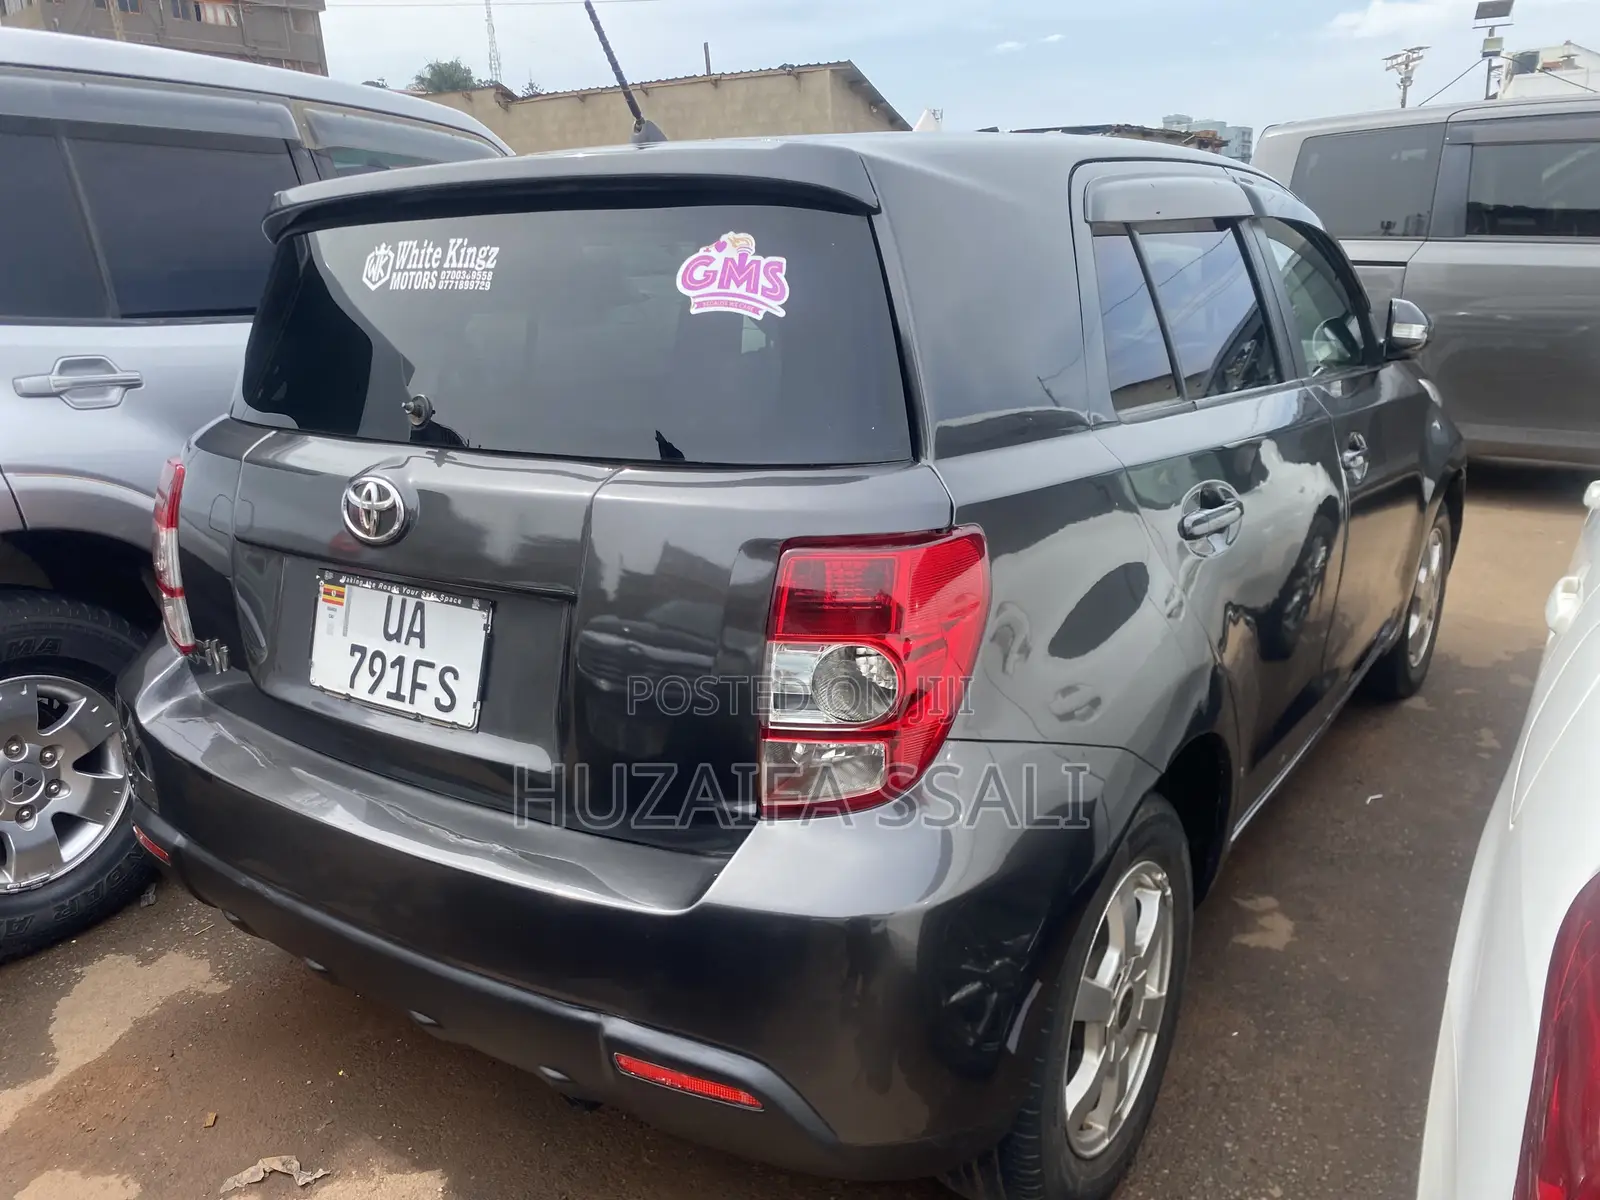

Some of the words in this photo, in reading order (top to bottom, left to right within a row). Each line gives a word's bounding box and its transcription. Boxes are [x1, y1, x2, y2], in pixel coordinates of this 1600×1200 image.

[395, 239, 442, 269] White
[443, 237, 500, 270] Kingz
[389, 270, 438, 290] MOTORS
[438, 280, 491, 291] 0771899729
[681, 254, 786, 302] GMS
[339, 575, 363, 587] Making
[402, 586, 419, 597] Your
[439, 593, 462, 605] Space
[382, 594, 427, 649] UA
[349, 643, 459, 713] 791FS
